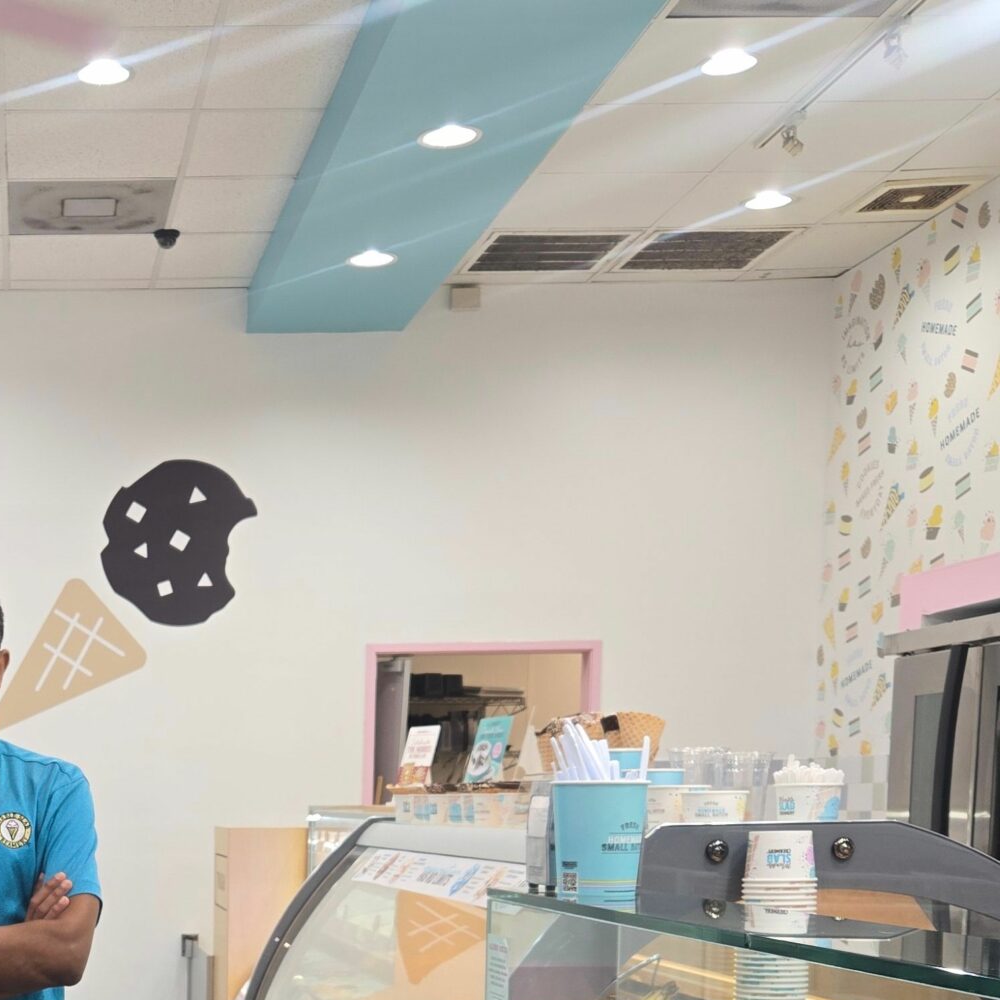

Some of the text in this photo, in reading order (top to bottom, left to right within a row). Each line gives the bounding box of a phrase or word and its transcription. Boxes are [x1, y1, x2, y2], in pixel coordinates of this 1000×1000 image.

[921, 321, 958, 336] HOMEMADE
[939, 407, 981, 450] HOMEMADE
[840, 659, 873, 689] HOMEMADE
[779, 801, 795, 811] SLAB
[601, 843, 629, 851] SMALL
[766, 854, 792, 864] SLAB
